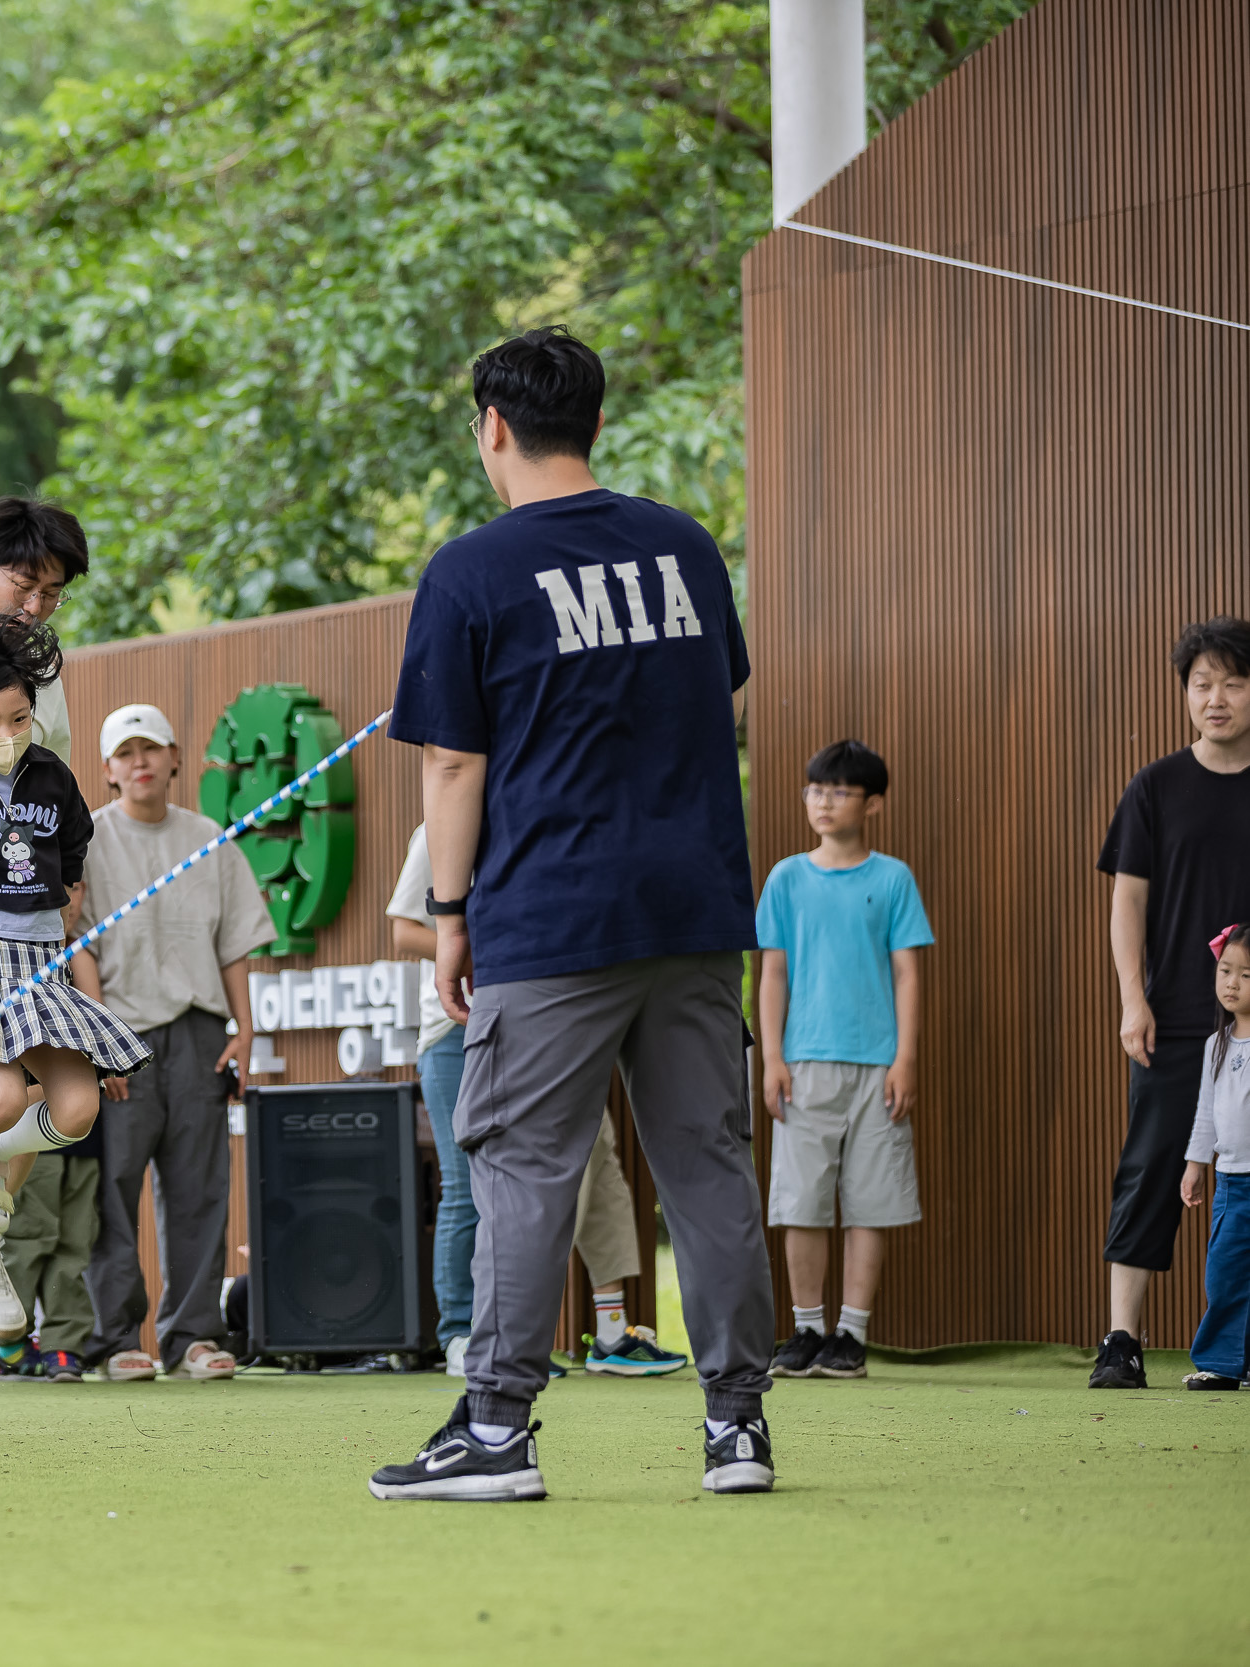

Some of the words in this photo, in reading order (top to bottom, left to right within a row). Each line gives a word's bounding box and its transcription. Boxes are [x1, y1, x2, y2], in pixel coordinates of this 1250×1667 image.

[535, 555, 702, 654] MIA
[282, 1112, 378, 1131] SECO
[739, 1437, 748, 1456] AIR
